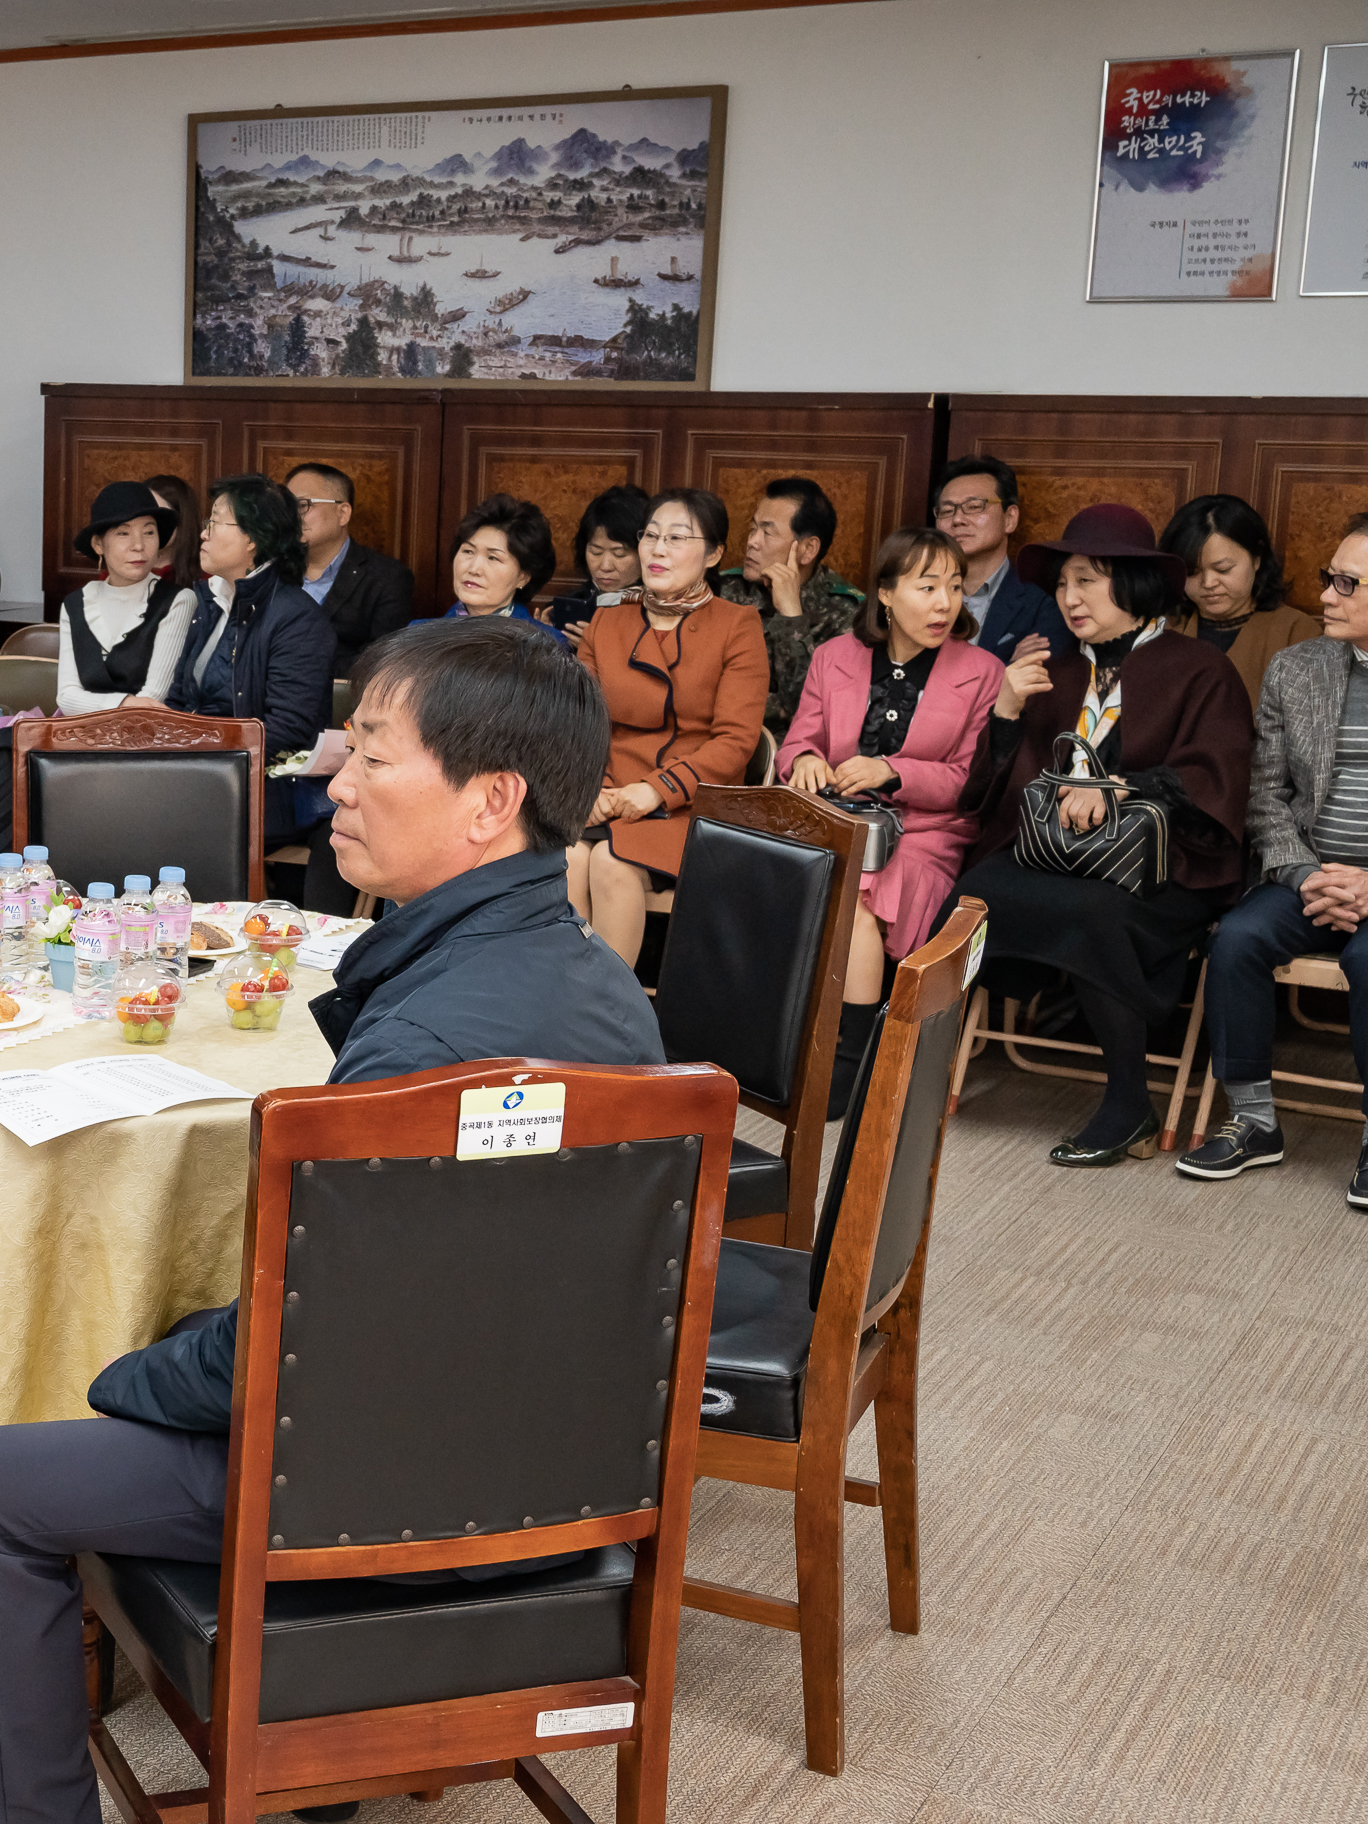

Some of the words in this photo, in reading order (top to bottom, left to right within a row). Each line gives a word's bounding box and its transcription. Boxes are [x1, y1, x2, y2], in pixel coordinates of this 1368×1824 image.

[1120, 87, 1172, 113] 국민의
[1176, 90, 1211, 108] 나라
[1120, 115, 1170, 133] 정의로운
[1117, 132, 1207, 160] 대한민국
[460, 1120, 493, 1131] 중곡제1동
